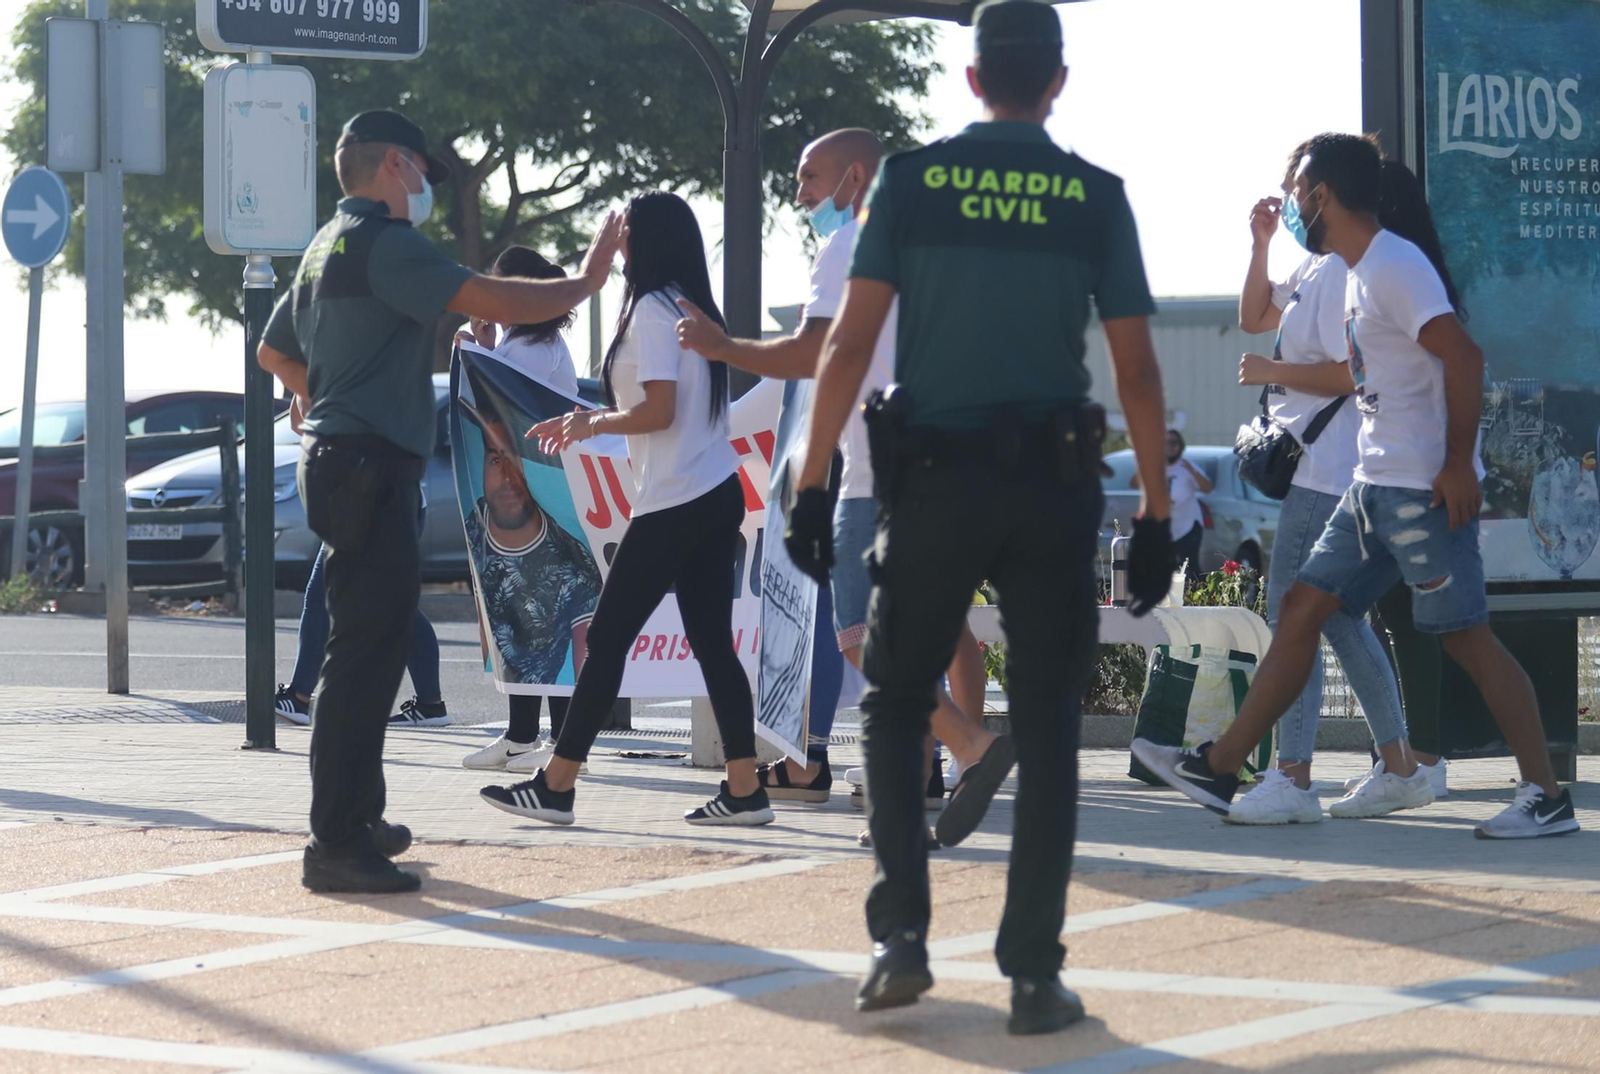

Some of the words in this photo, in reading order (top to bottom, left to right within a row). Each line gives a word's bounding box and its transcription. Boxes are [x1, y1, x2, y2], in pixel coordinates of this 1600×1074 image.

[270, 0, 307, 16] 607
[317, 0, 350, 19] 977
[362, 1, 400, 24] 999
[294, 28, 397, 45] www.imagenand-nt.com
[1438, 72, 1583, 159] LARIOS
[1520, 157, 1599, 172] RECUPER
[924, 165, 1085, 202] GUARDIA
[1520, 179, 1600, 195] NUESTRO
[960, 195, 1047, 224] CIVIL
[1519, 224, 1598, 239] MEDITER
